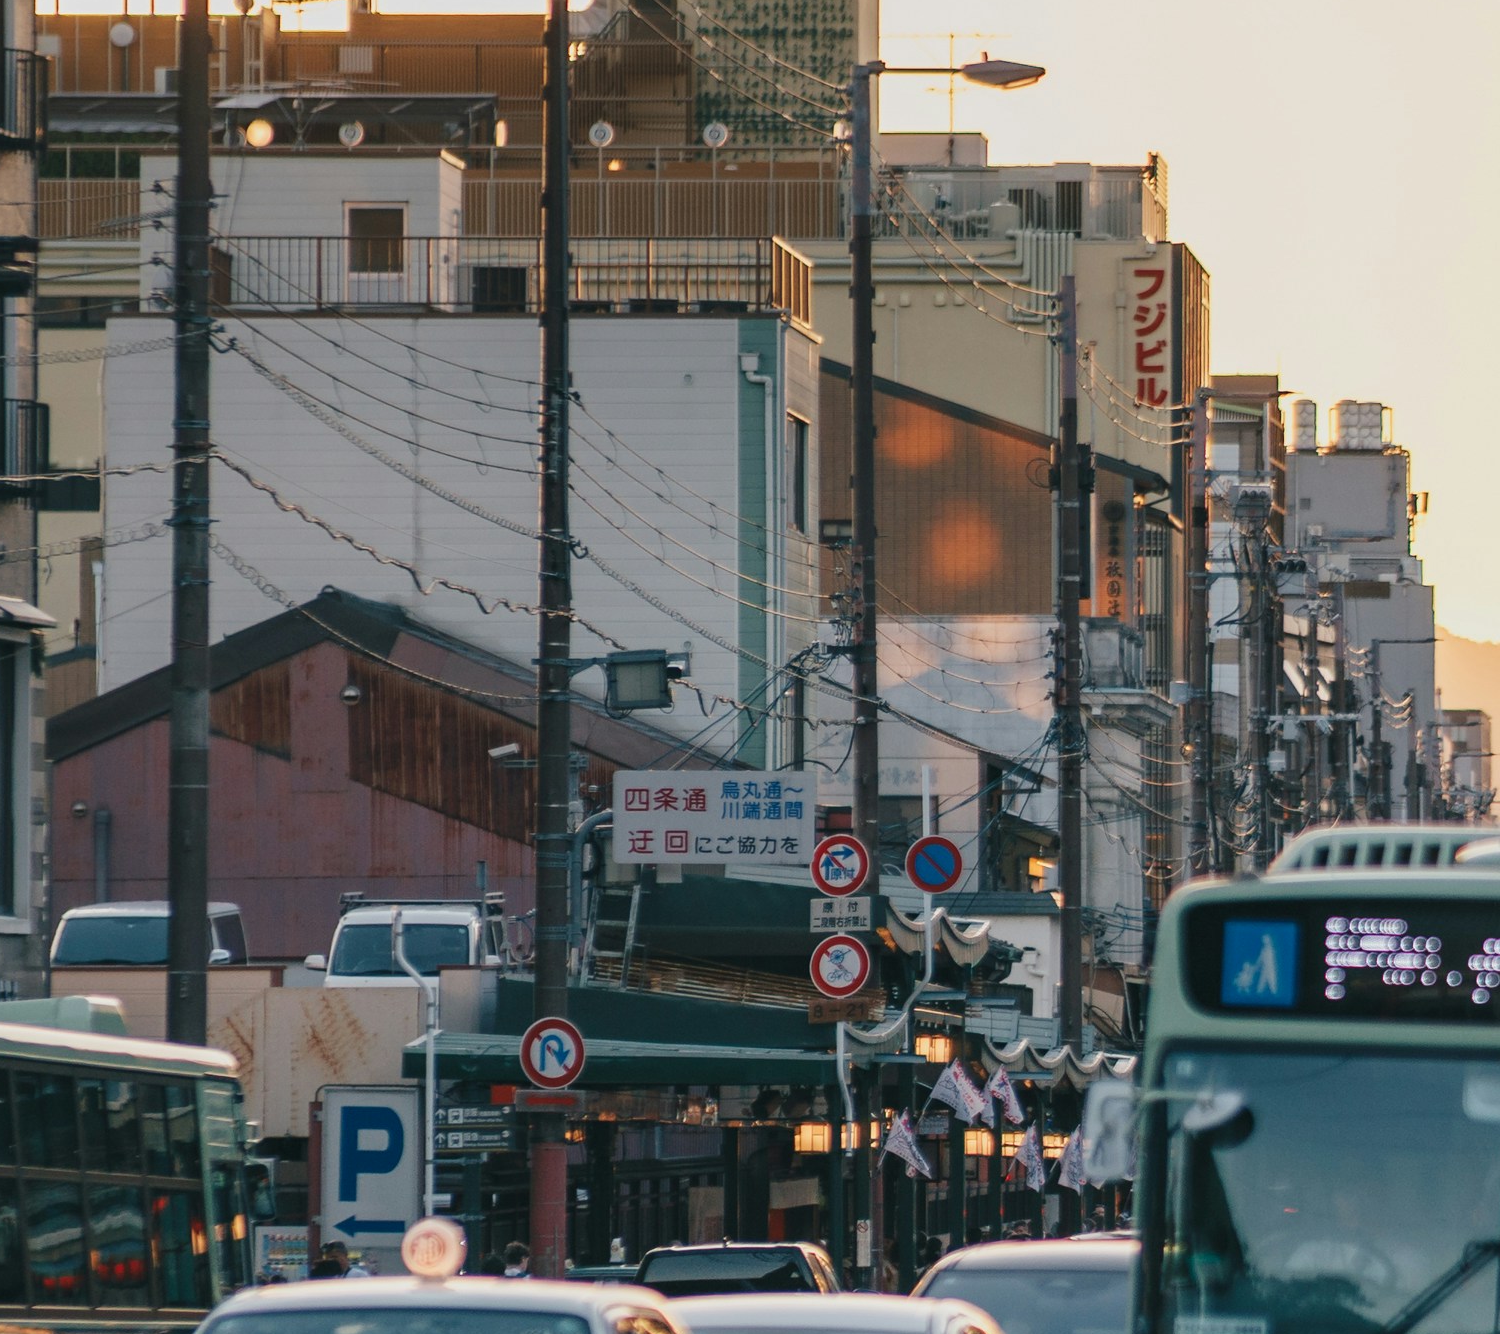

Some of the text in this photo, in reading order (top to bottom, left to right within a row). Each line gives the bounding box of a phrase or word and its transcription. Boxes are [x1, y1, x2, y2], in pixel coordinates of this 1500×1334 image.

[1133, 269, 1168, 407] フジビル
[624, 787, 707, 812] 四条通
[720, 801, 804, 820] 川端通間
[830, 867, 855, 881] 原付
[822, 901, 859, 914] 原付
[812, 917, 868, 928] 二段階右折禁止
[338, 1106, 404, 1202] P
